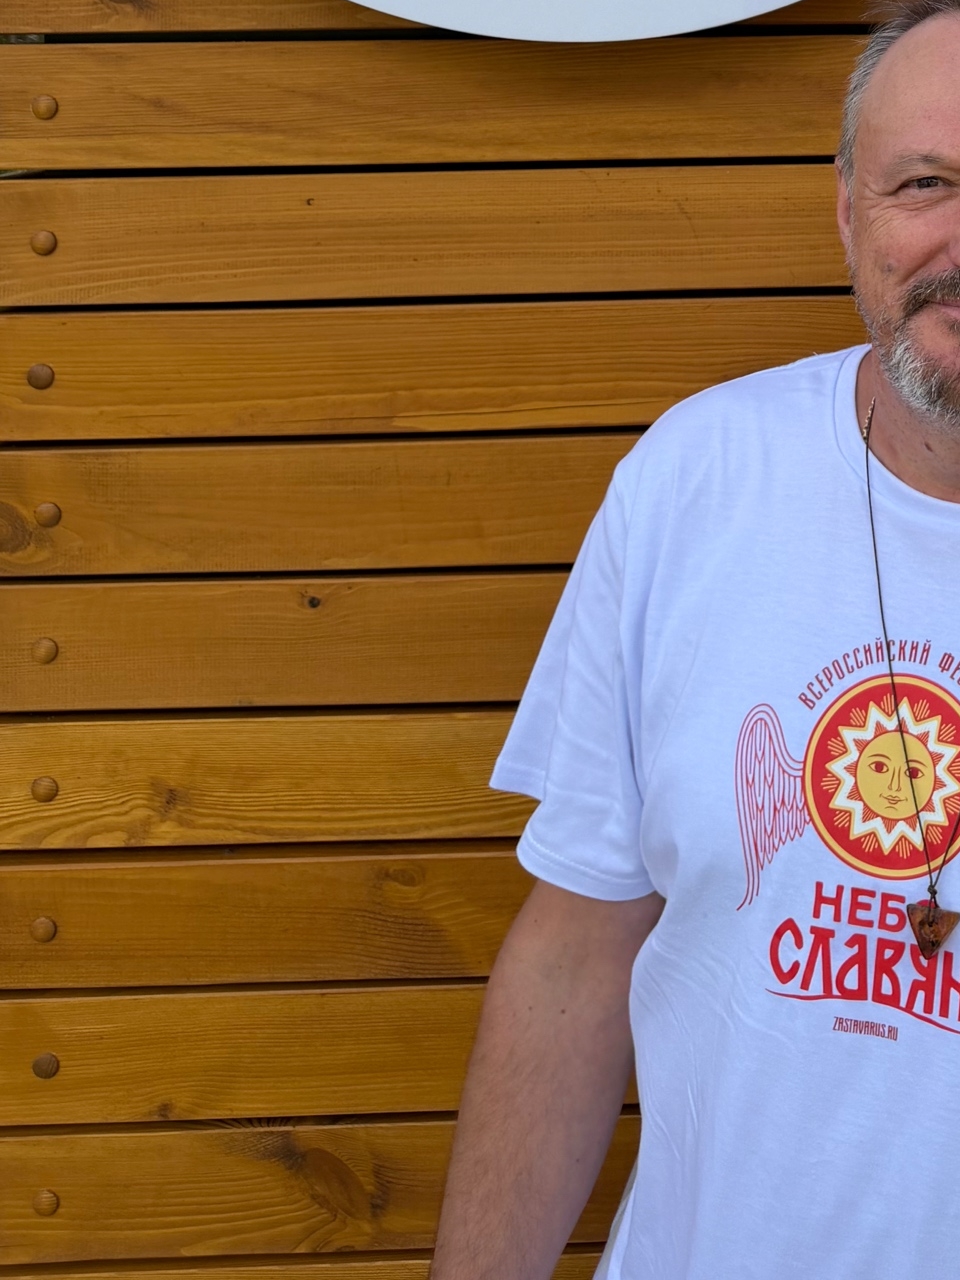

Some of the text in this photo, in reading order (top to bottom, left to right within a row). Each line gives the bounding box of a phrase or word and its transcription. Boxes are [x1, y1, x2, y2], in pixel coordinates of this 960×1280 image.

[798, 636, 932, 710] ВСЕРОССИЙСКИЙ
[812, 881, 938, 933] НЕБ
[832, 1016, 899, 1041] ZASTAVARUS.RU
